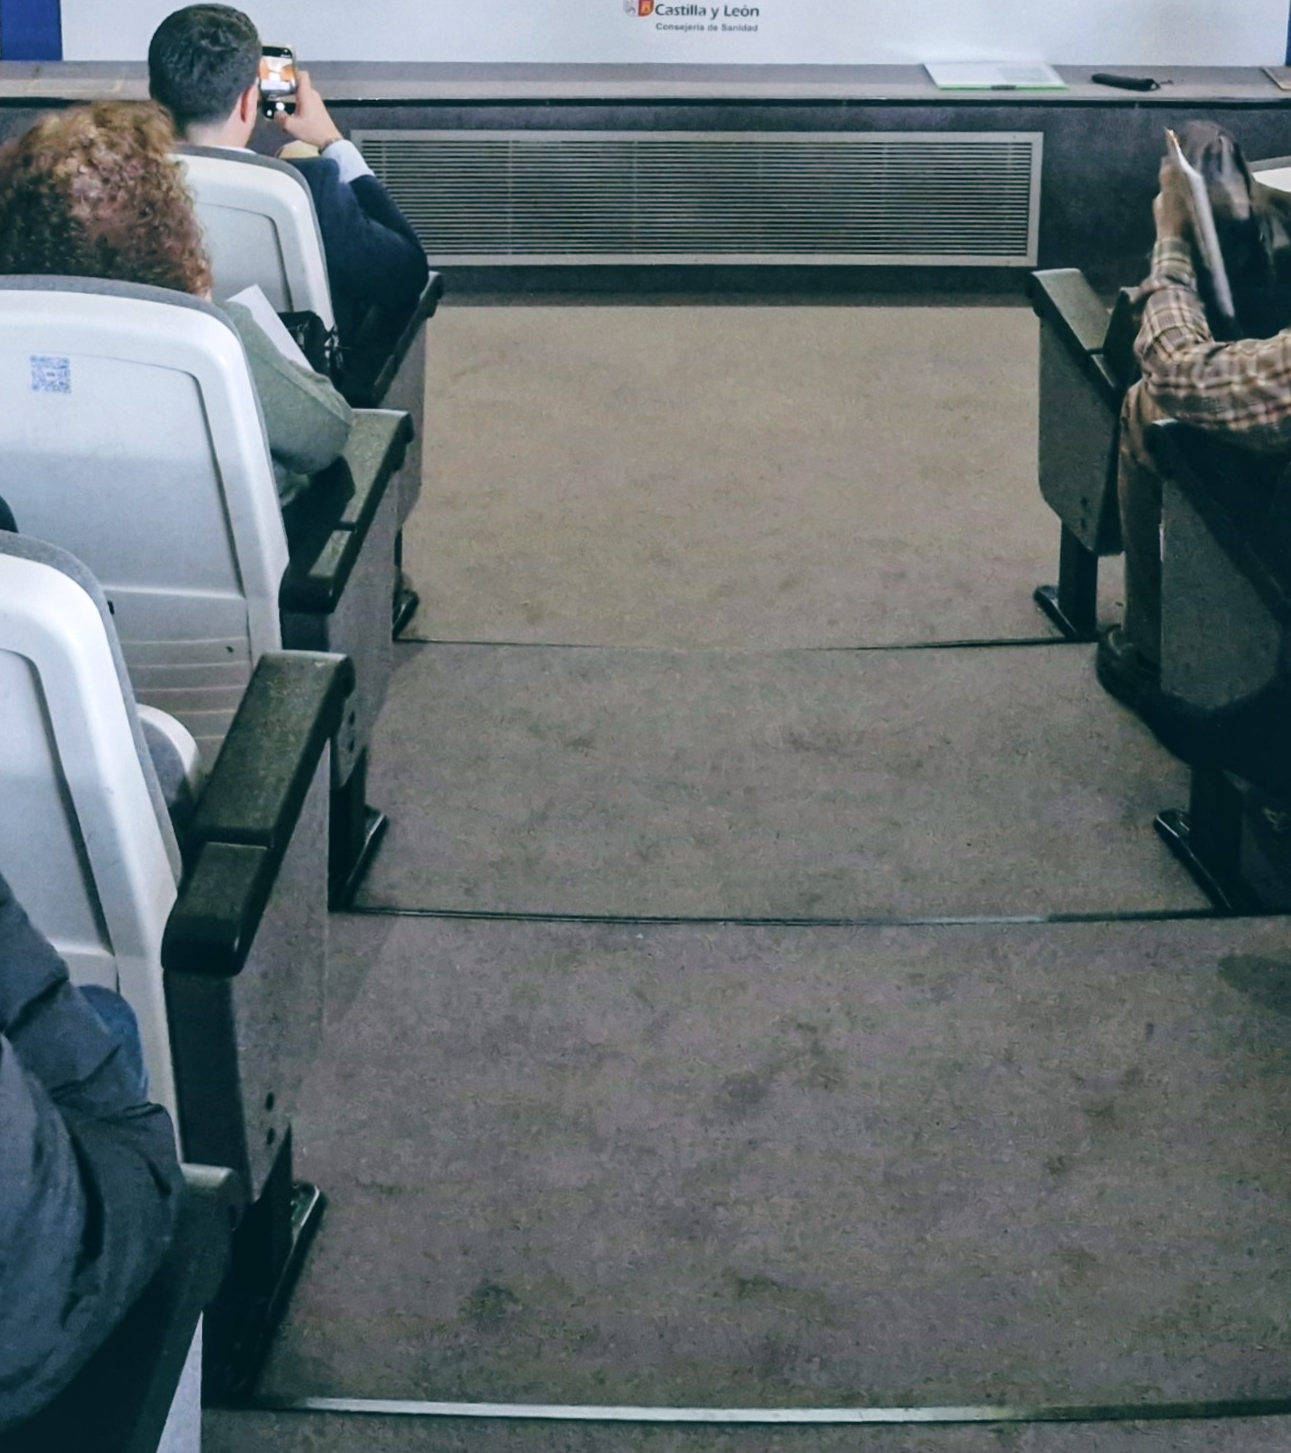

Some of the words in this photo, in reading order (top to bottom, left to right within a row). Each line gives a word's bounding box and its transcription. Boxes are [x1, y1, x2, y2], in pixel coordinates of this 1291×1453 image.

[655, 3, 707, 17] Castilla
[711, 7, 719, 20] y
[723, 4, 760, 18] León
[707, 23, 719, 33] de
[721, 23, 759, 33] Sanidad
